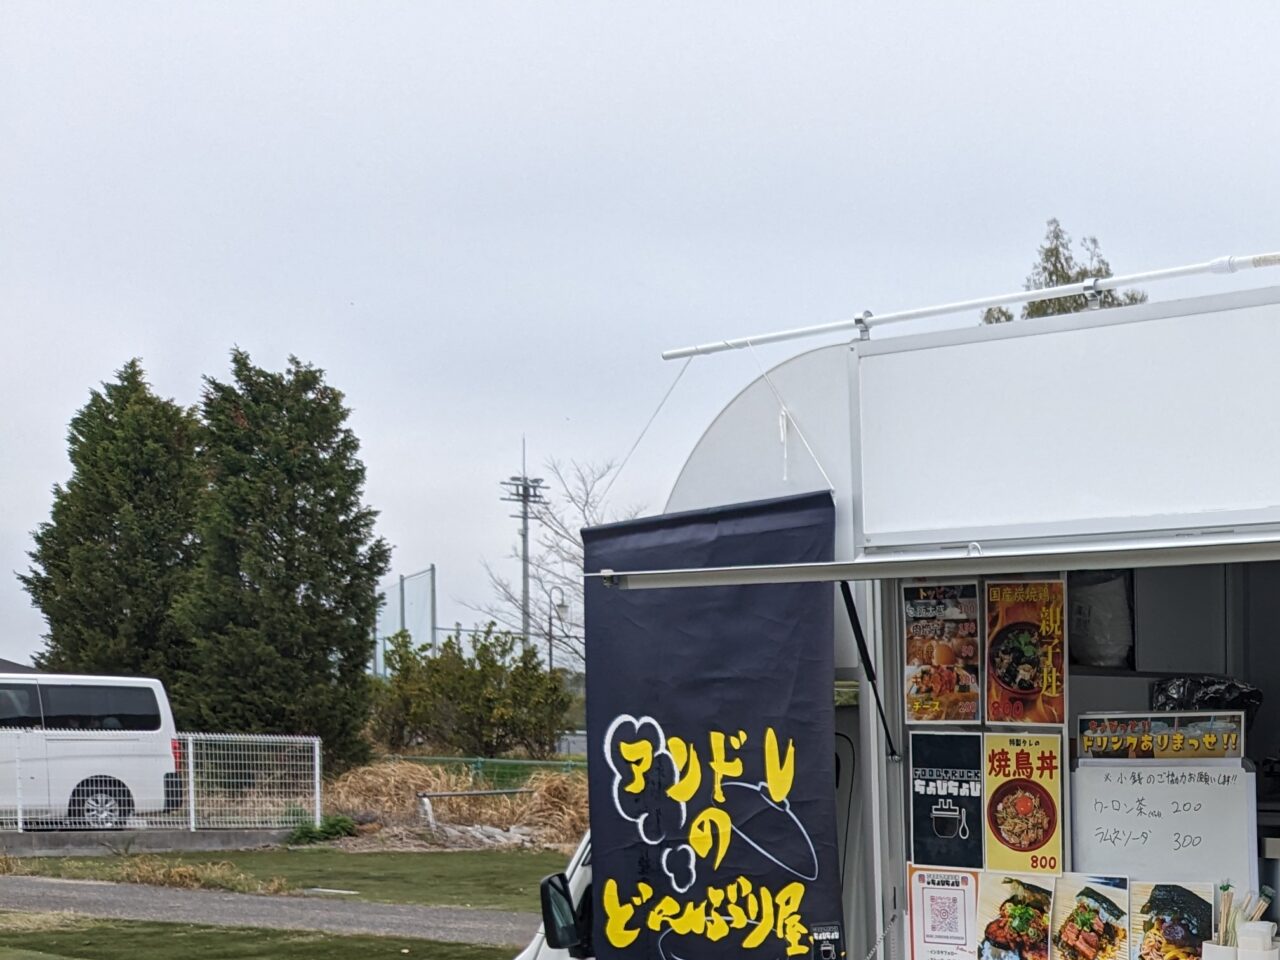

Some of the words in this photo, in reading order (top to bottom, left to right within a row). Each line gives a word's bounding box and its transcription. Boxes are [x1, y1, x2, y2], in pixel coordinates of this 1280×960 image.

[991, 701, 1024, 717] 800
[619, 727, 796, 803] アンドレ
[988, 748, 1059, 780] 焼鳥丼
[1171, 800, 1202, 814] 200
[689, 807, 731, 870] の
[1173, 832, 1202, 851] 300
[1030, 855, 1057, 869] 800
[604, 876, 812, 957] どんぶり屋
